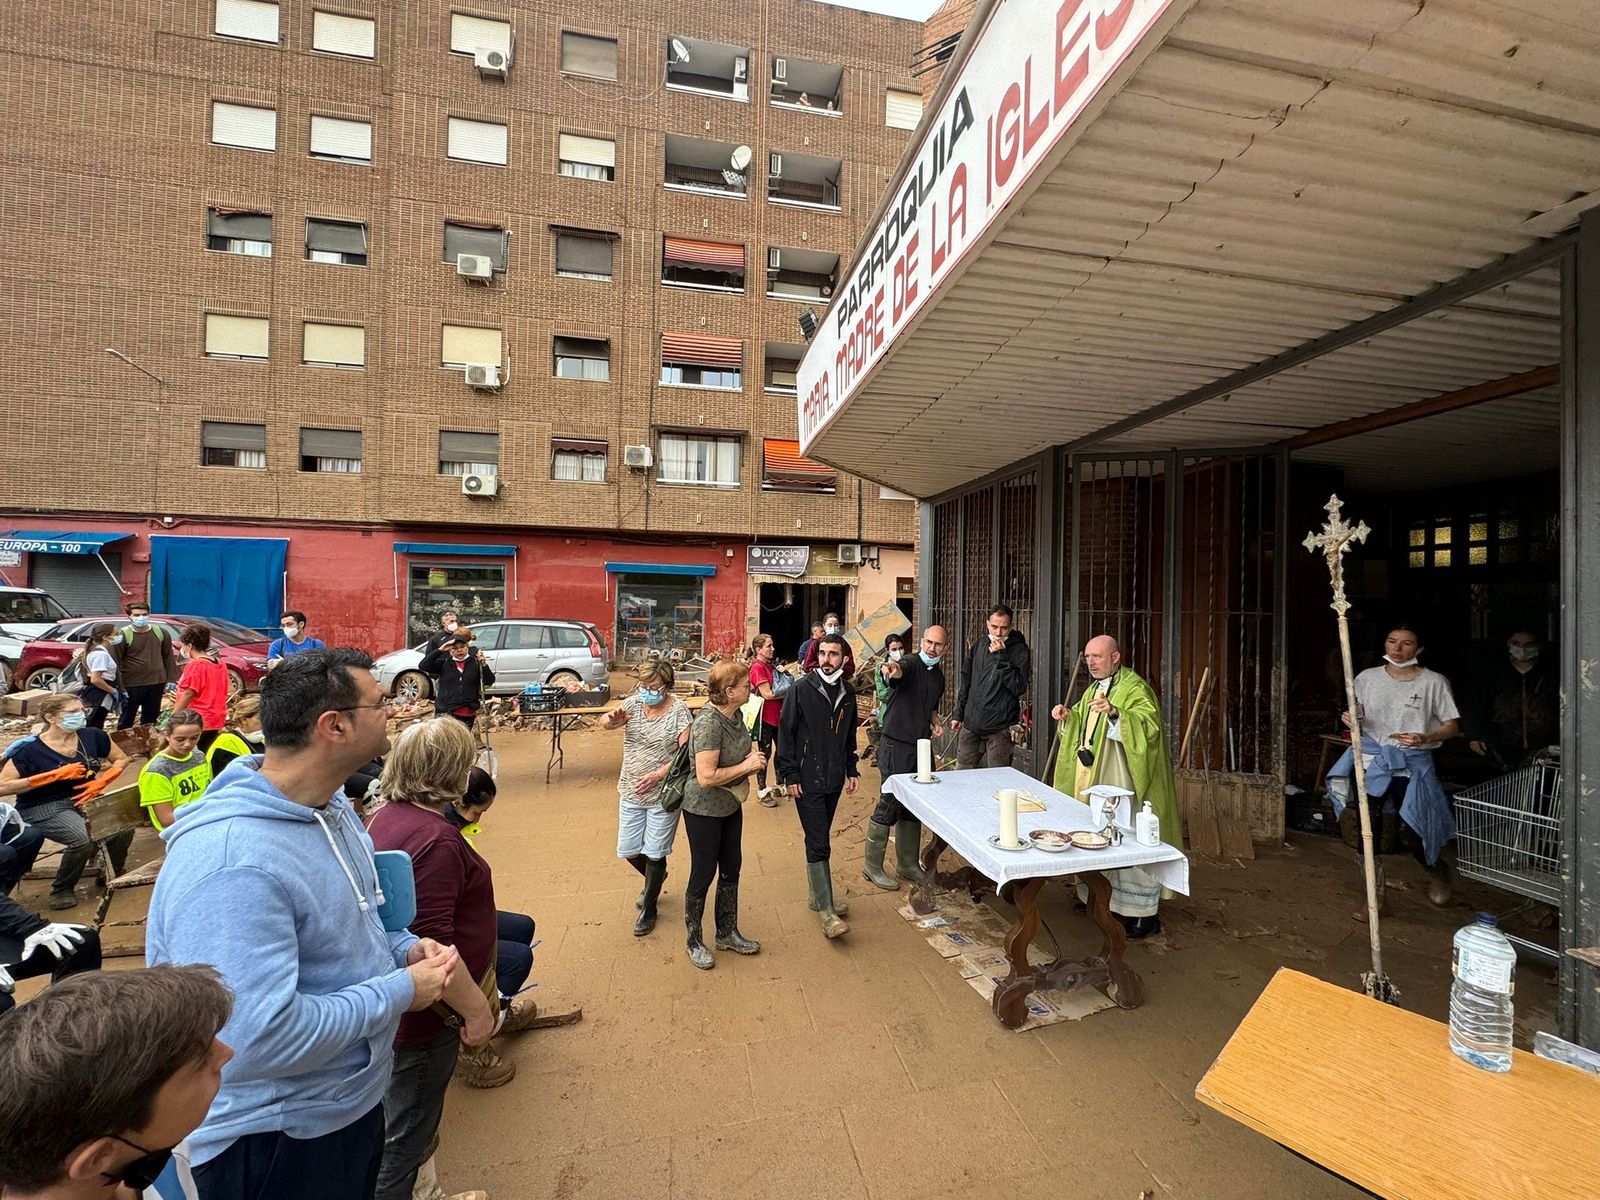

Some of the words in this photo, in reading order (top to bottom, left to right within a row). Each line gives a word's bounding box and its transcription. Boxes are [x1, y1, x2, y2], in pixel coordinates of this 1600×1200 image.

[835, 282, 884, 400] MADRE
[892, 229, 919, 329] DE
[931, 162, 967, 278] LA
[837, 86, 974, 340] PARROQUIA
[60, 543, 81, 552] 100
